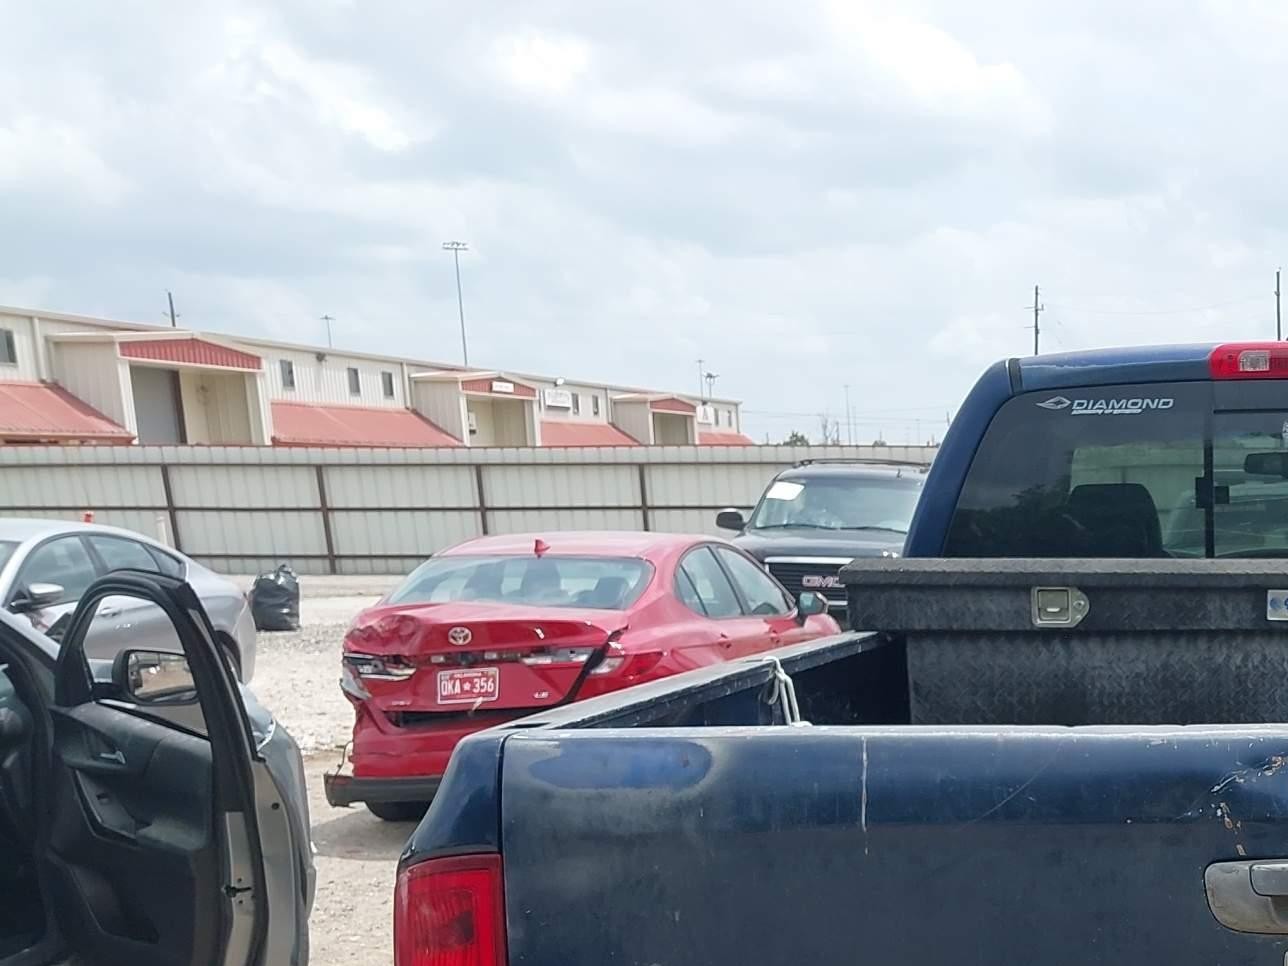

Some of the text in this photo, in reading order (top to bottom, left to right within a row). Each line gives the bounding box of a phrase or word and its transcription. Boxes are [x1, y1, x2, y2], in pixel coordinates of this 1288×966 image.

[1072, 398, 1175, 410] DIAMOND
[802, 575, 846, 589] GMC
[472, 677, 494, 693] 356
